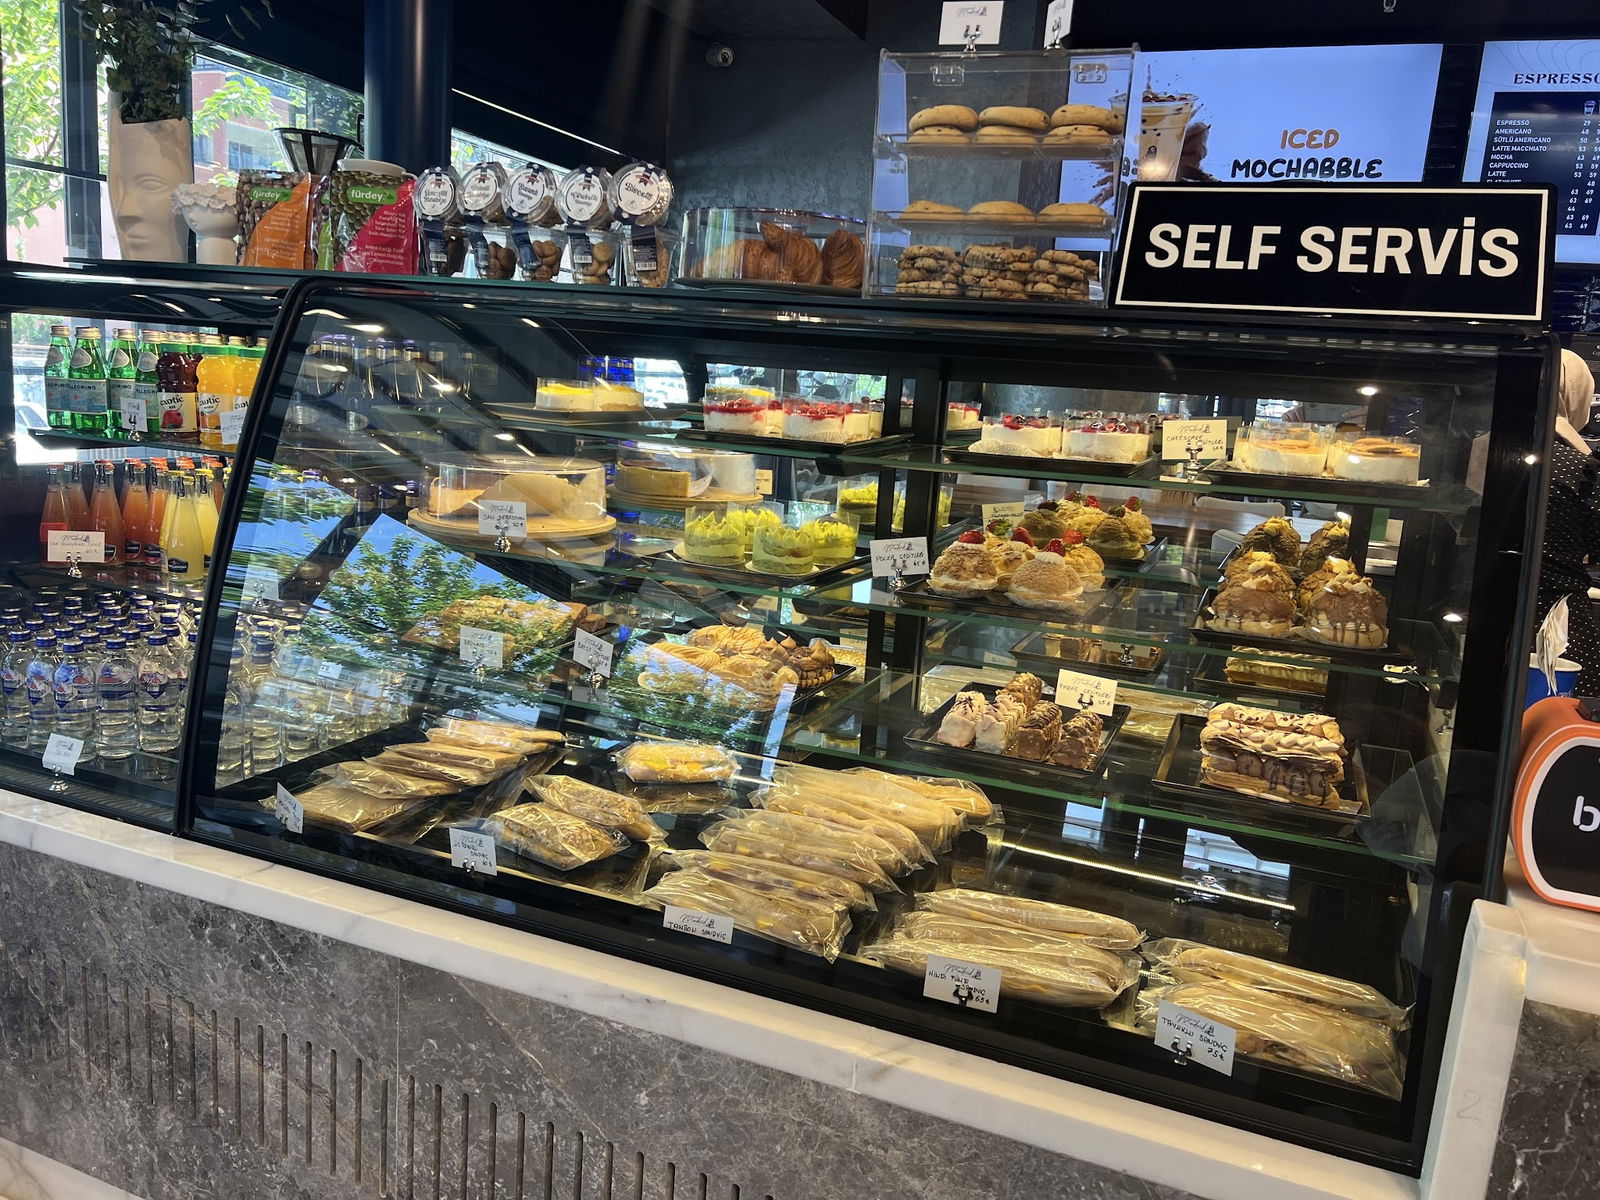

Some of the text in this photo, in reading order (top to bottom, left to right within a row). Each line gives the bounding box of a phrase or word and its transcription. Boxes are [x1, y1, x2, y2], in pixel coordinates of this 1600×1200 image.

[1280, 128, 1340, 150] ICED
[1230, 157, 1383, 179] MOCHABBLE
[252, 189, 281, 201] fürdey
[351, 190, 384, 202] fürdey
[1144, 216, 1519, 277] SELF SERVİS
